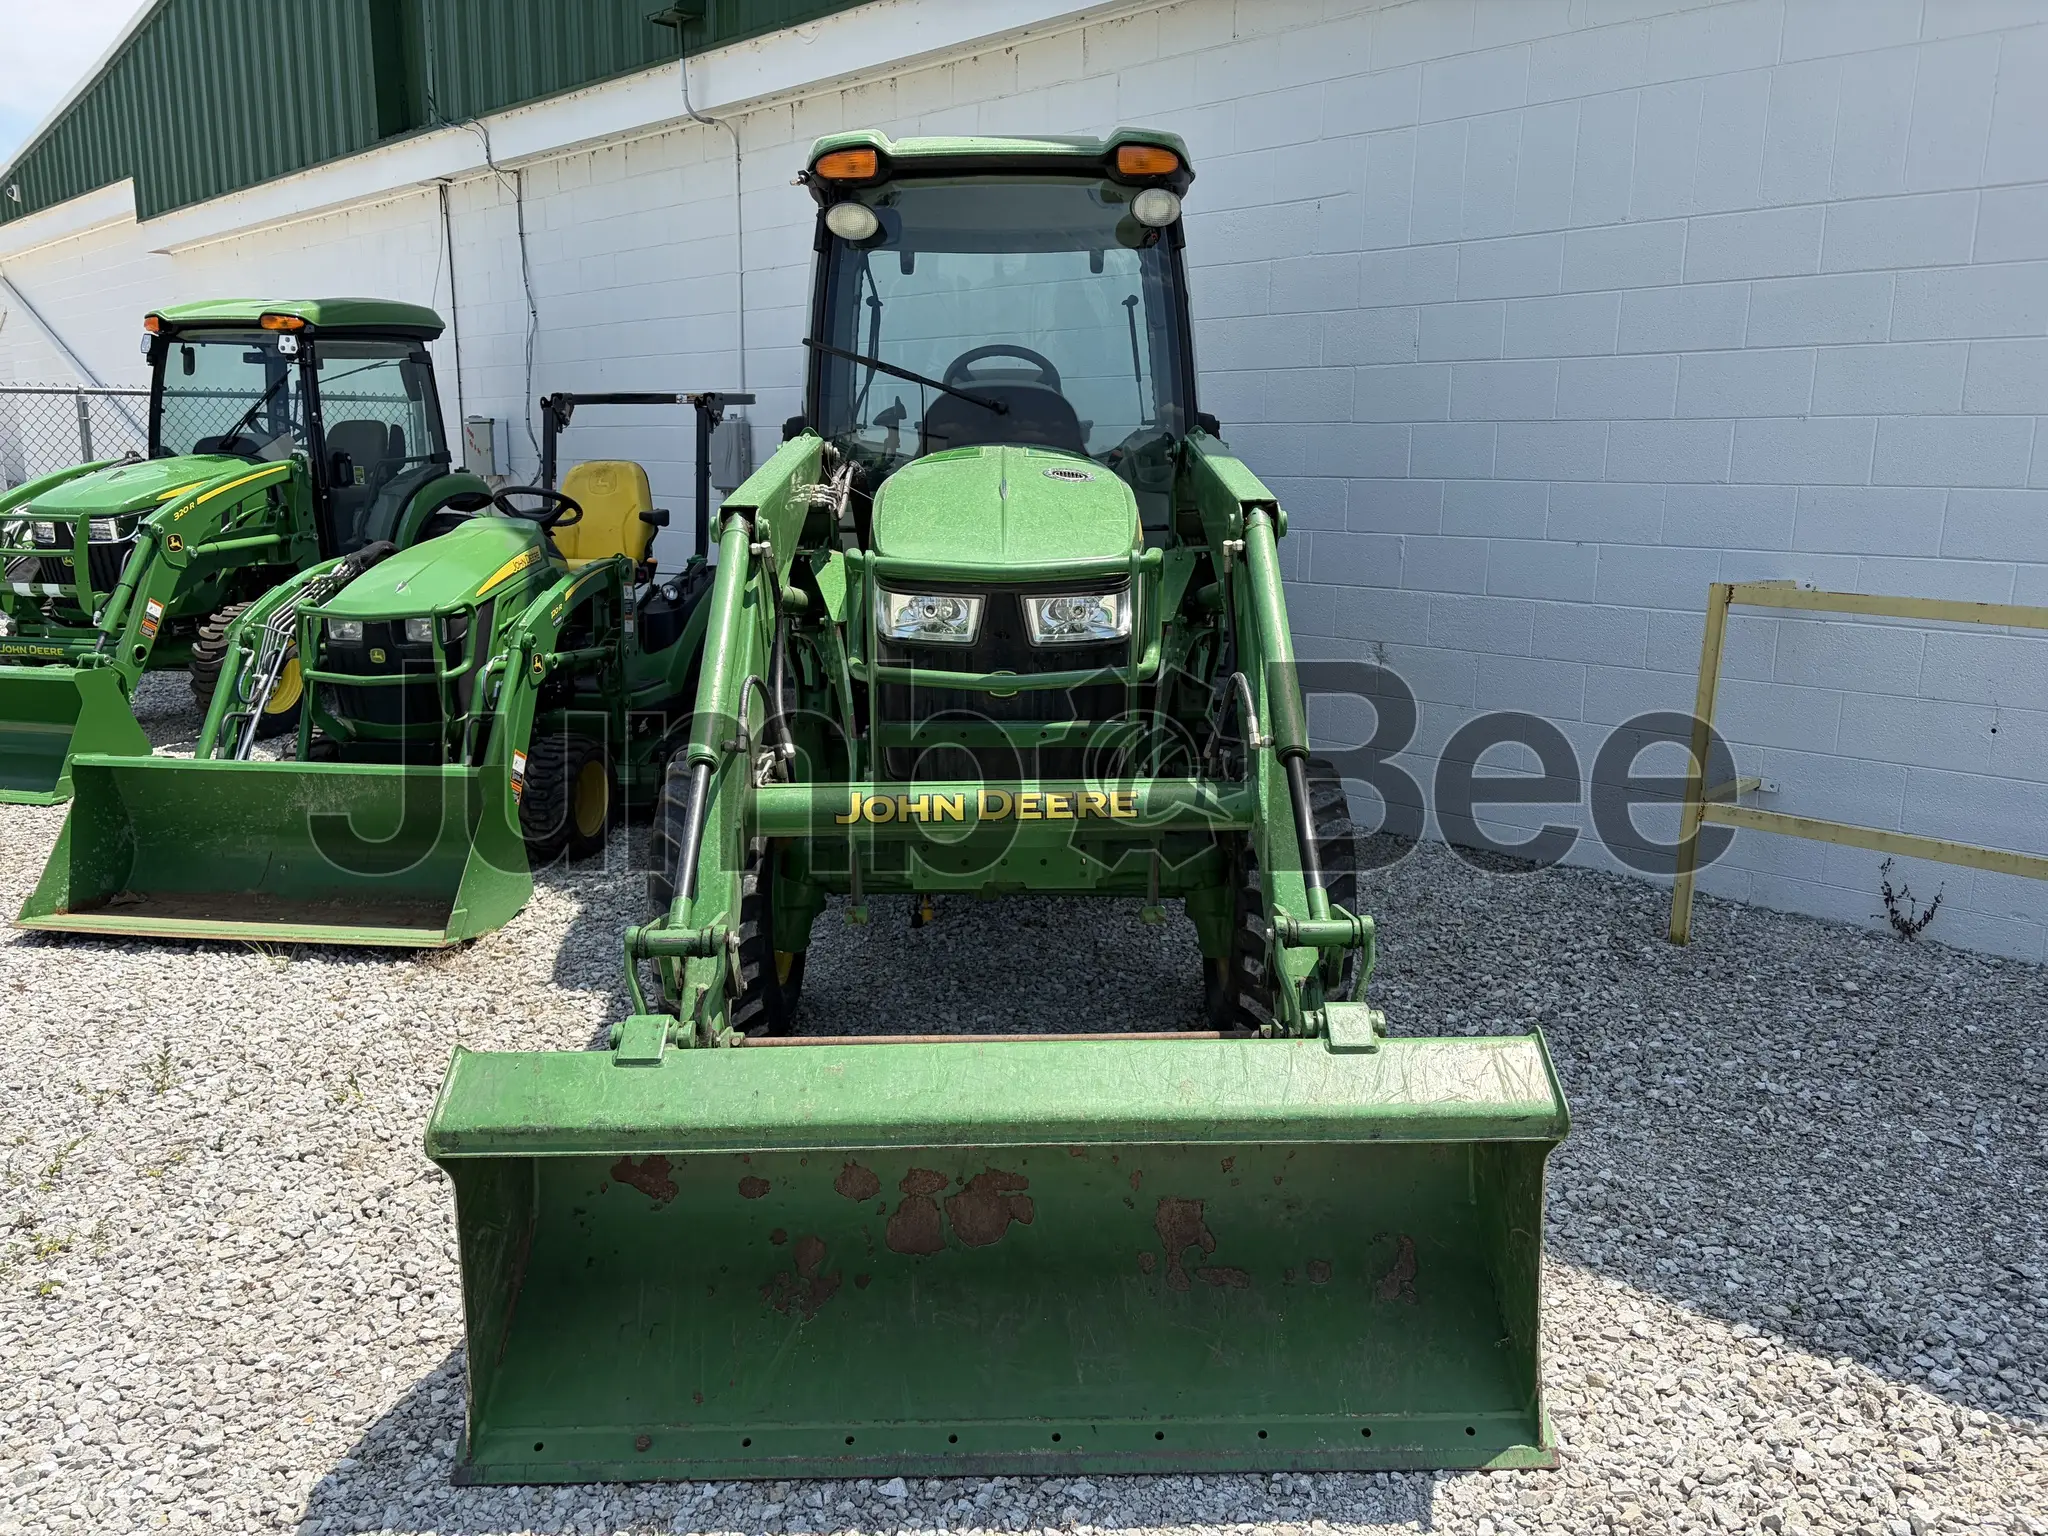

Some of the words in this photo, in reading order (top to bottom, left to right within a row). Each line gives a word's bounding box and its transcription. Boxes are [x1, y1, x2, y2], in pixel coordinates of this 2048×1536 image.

[0, 643, 27, 654] JOHN
[28, 644, 65, 656] DEERE
[834, 790, 967, 825] JOHN
[976, 788, 1139, 822] DEERE
